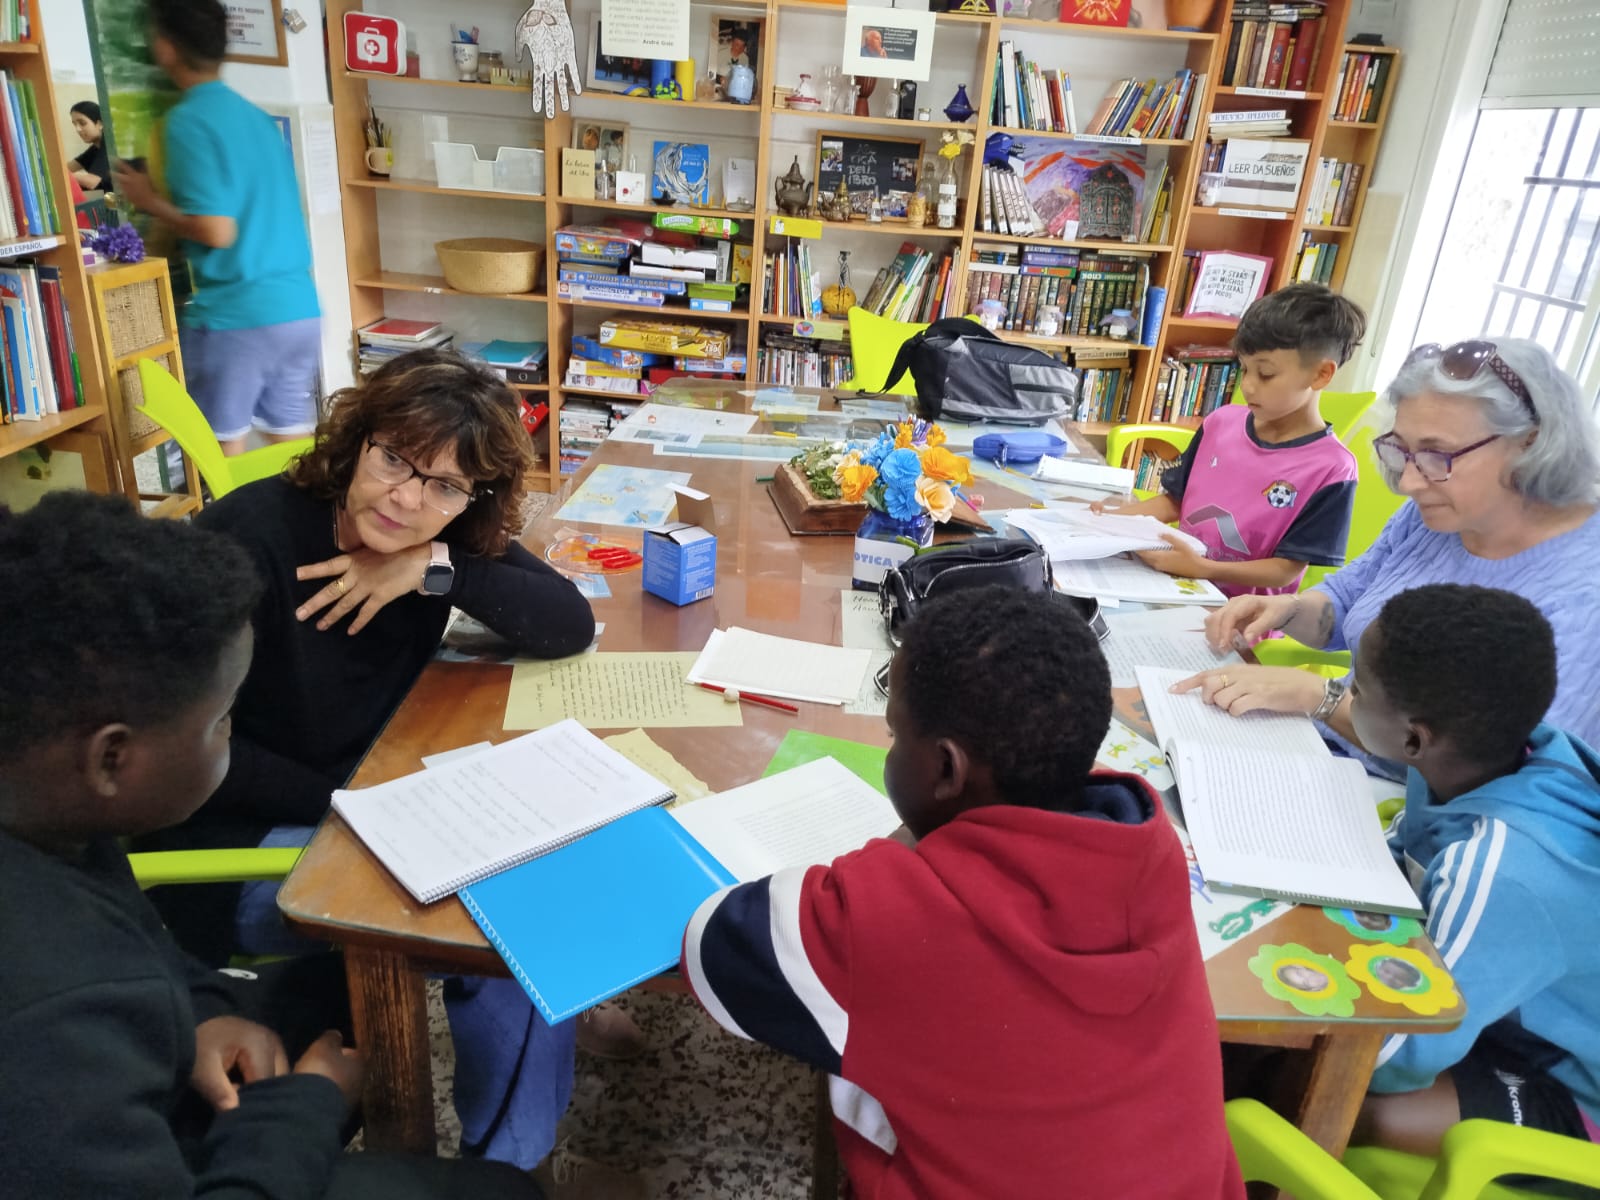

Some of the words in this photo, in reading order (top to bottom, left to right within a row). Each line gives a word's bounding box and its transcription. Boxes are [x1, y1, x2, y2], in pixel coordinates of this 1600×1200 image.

[1228, 163, 1250, 174] LEER
[1252, 164, 1264, 175] DA
[1264, 162, 1296, 177] SUEÑOS
[855, 551, 893, 567] OTICA
